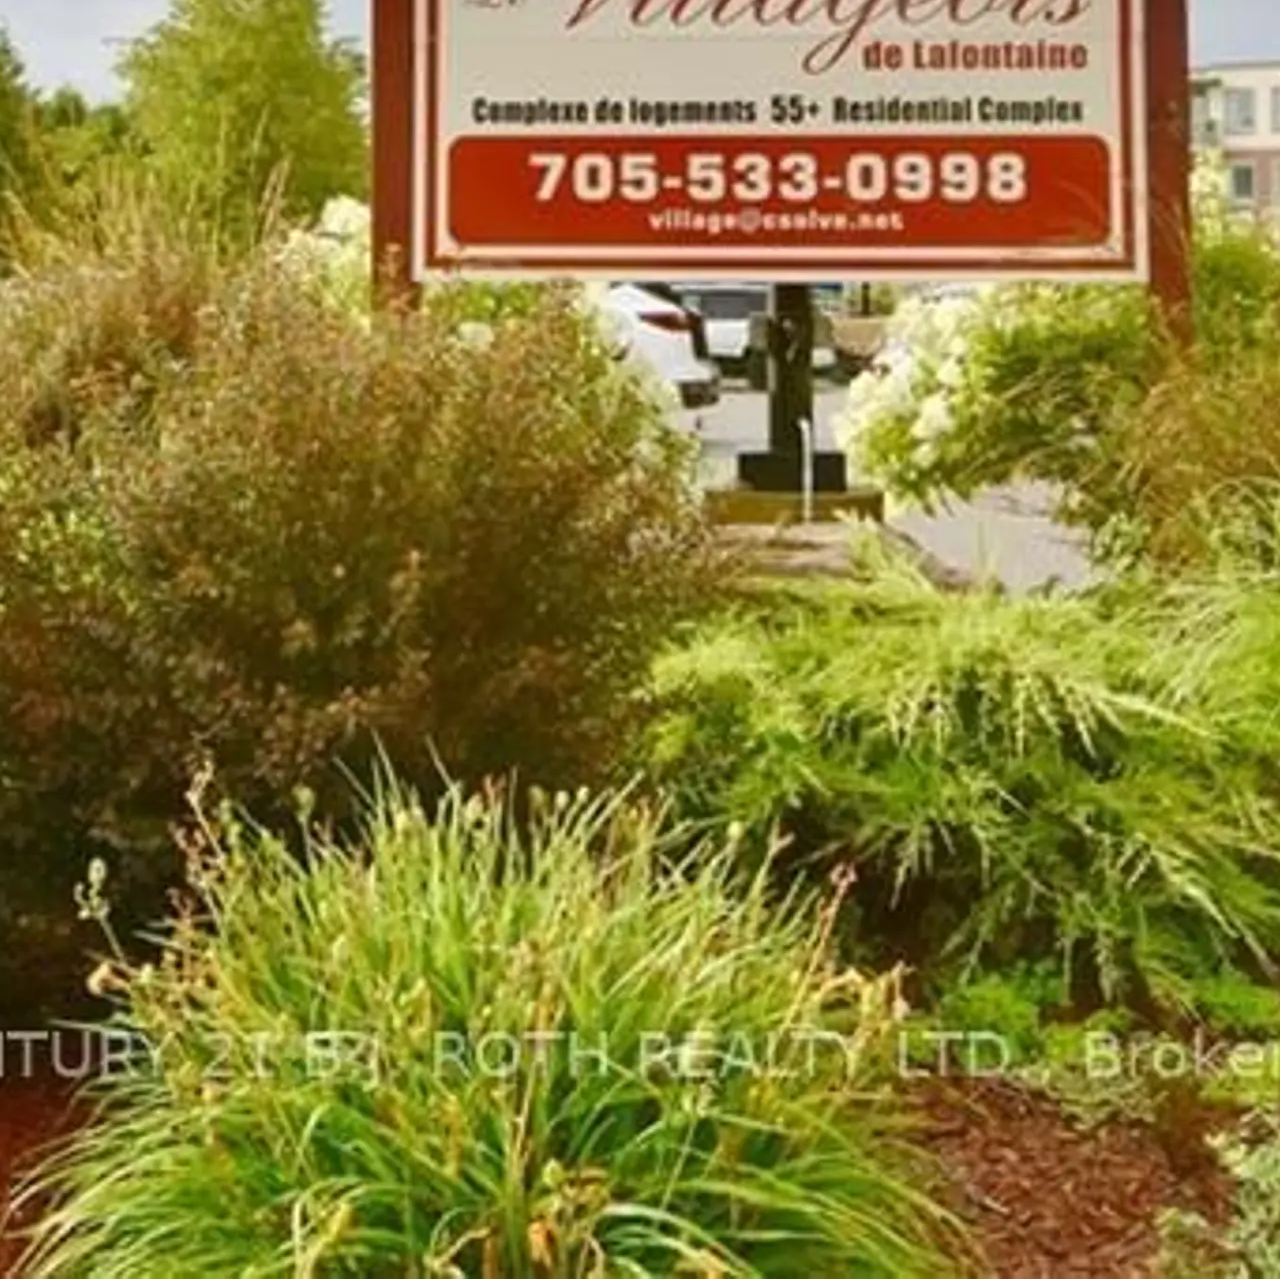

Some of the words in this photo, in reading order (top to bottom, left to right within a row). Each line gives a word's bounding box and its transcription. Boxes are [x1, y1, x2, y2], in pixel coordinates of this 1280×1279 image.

[863, 40, 903, 70] de
[913, 40, 1088, 70] Lafontaine
[473, 97, 589, 125] Complexe
[594, 98, 624, 123] de
[630, 98, 757, 126] logements
[771, 95, 821, 123] 55+
[833, 97, 972, 122] Residential
[978, 97, 1083, 125] Complex
[528, 152, 1027, 203] 705-533-0998
[648, 208, 905, 234] village@csolve.net
